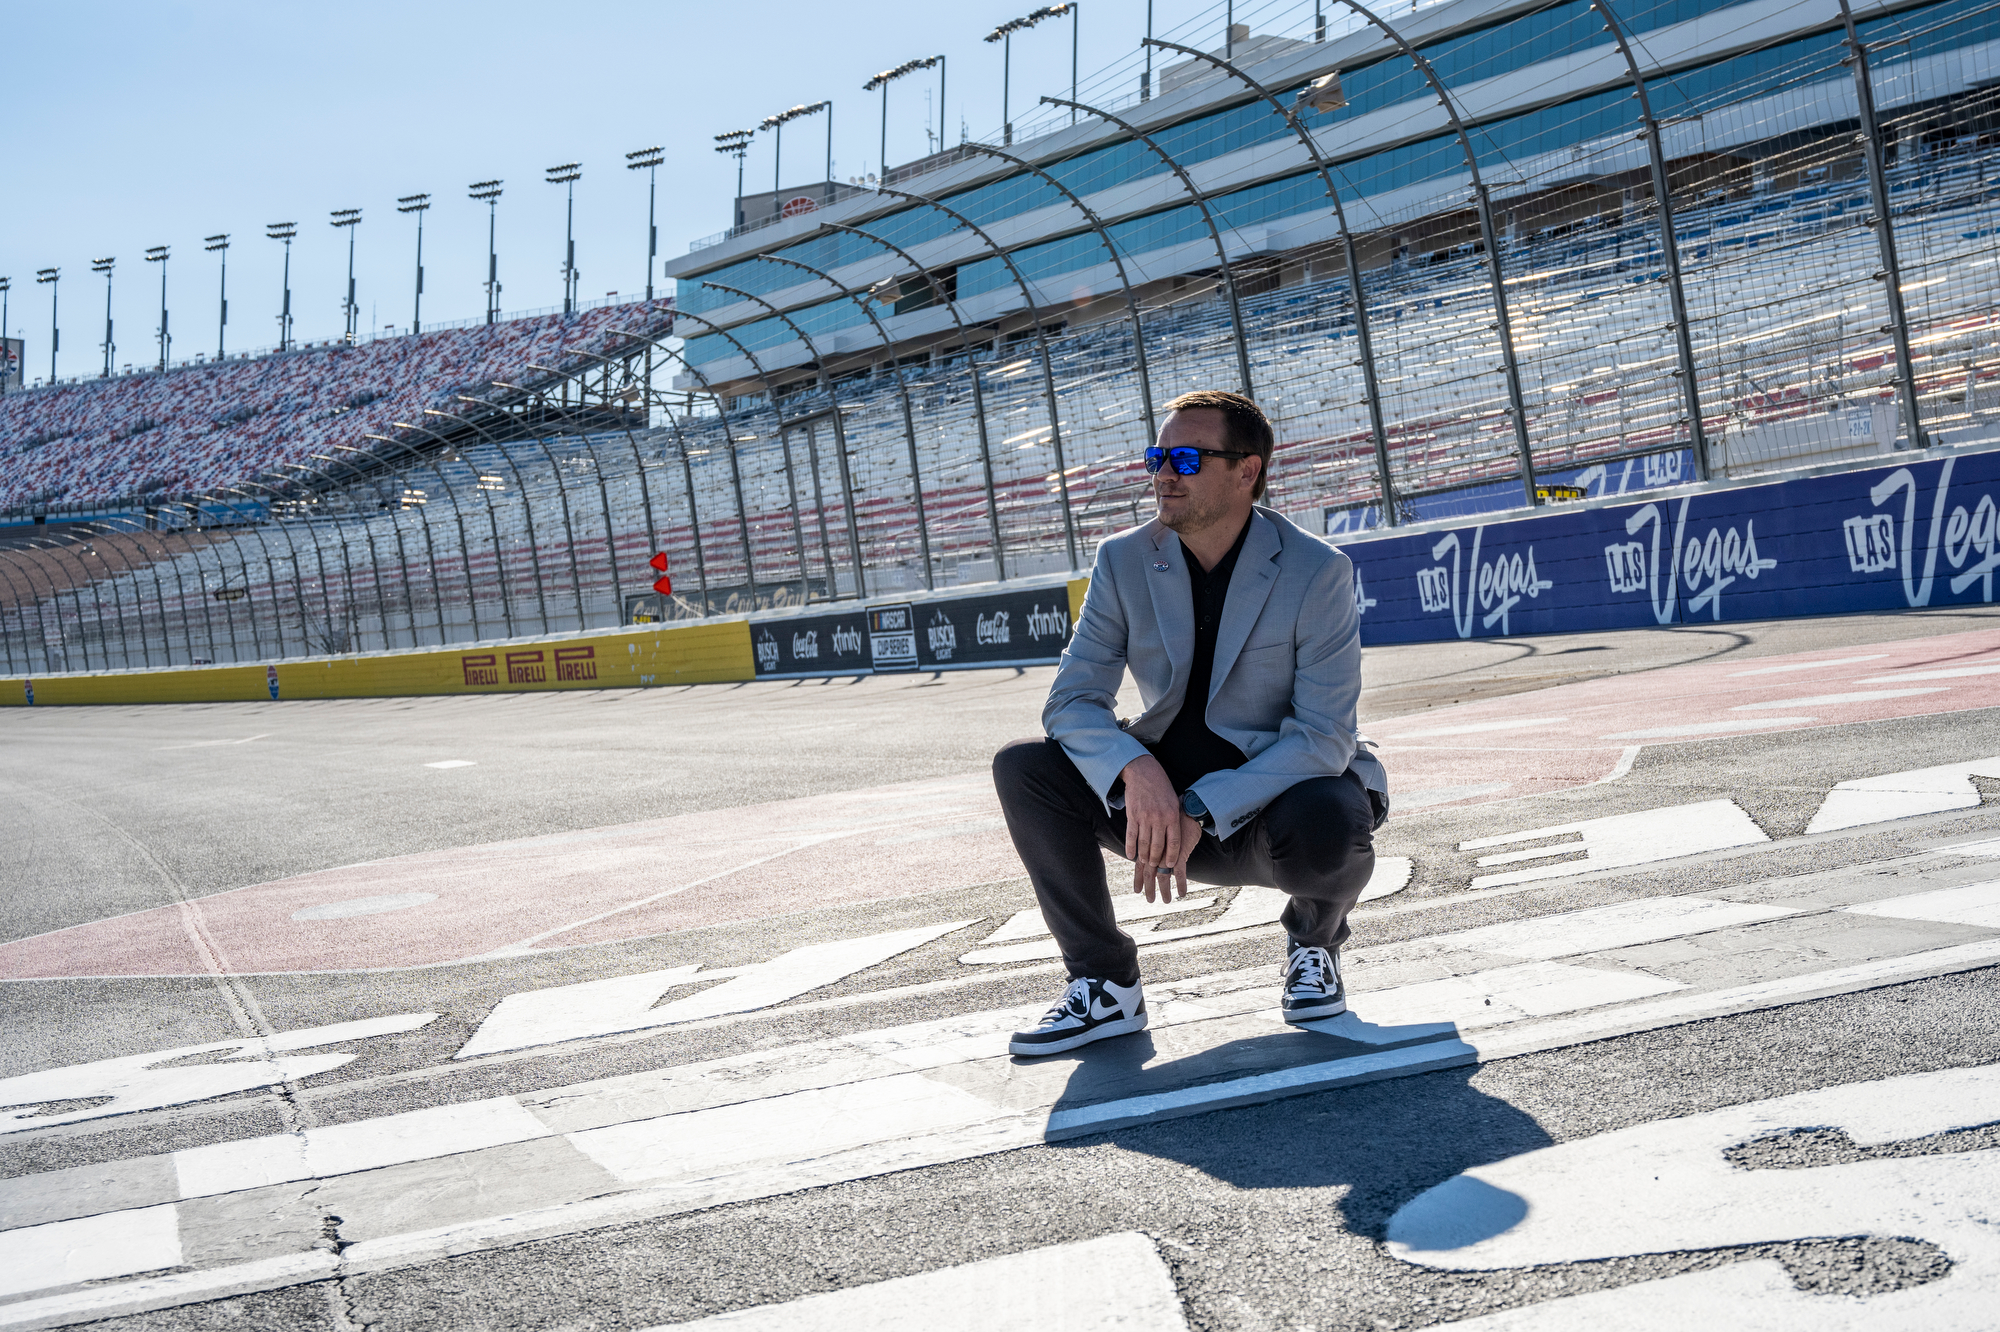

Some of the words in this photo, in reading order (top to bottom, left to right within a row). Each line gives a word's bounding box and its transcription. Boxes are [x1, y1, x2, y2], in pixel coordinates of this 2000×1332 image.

[1843, 514, 1897, 574] LAS
[1870, 457, 2000, 607] Veg
[1604, 541, 1647, 593] LAS
[1625, 496, 1778, 625] Vegas
[1417, 567, 1450, 612] LAS
[1432, 525, 1553, 638] Vegas
[882, 610, 907, 630] NASCAR
[927, 624, 957, 650] BUSCH
[1026, 604, 1068, 642] xfinity
[757, 641, 780, 664] BUSCH
[831, 625, 862, 656] xfinity
[889, 638, 910, 656] SERIES
[462, 654, 499, 686] PIRELLI
[505, 650, 547, 684] PIRELLI
[554, 646, 598, 681] PIRELLI
